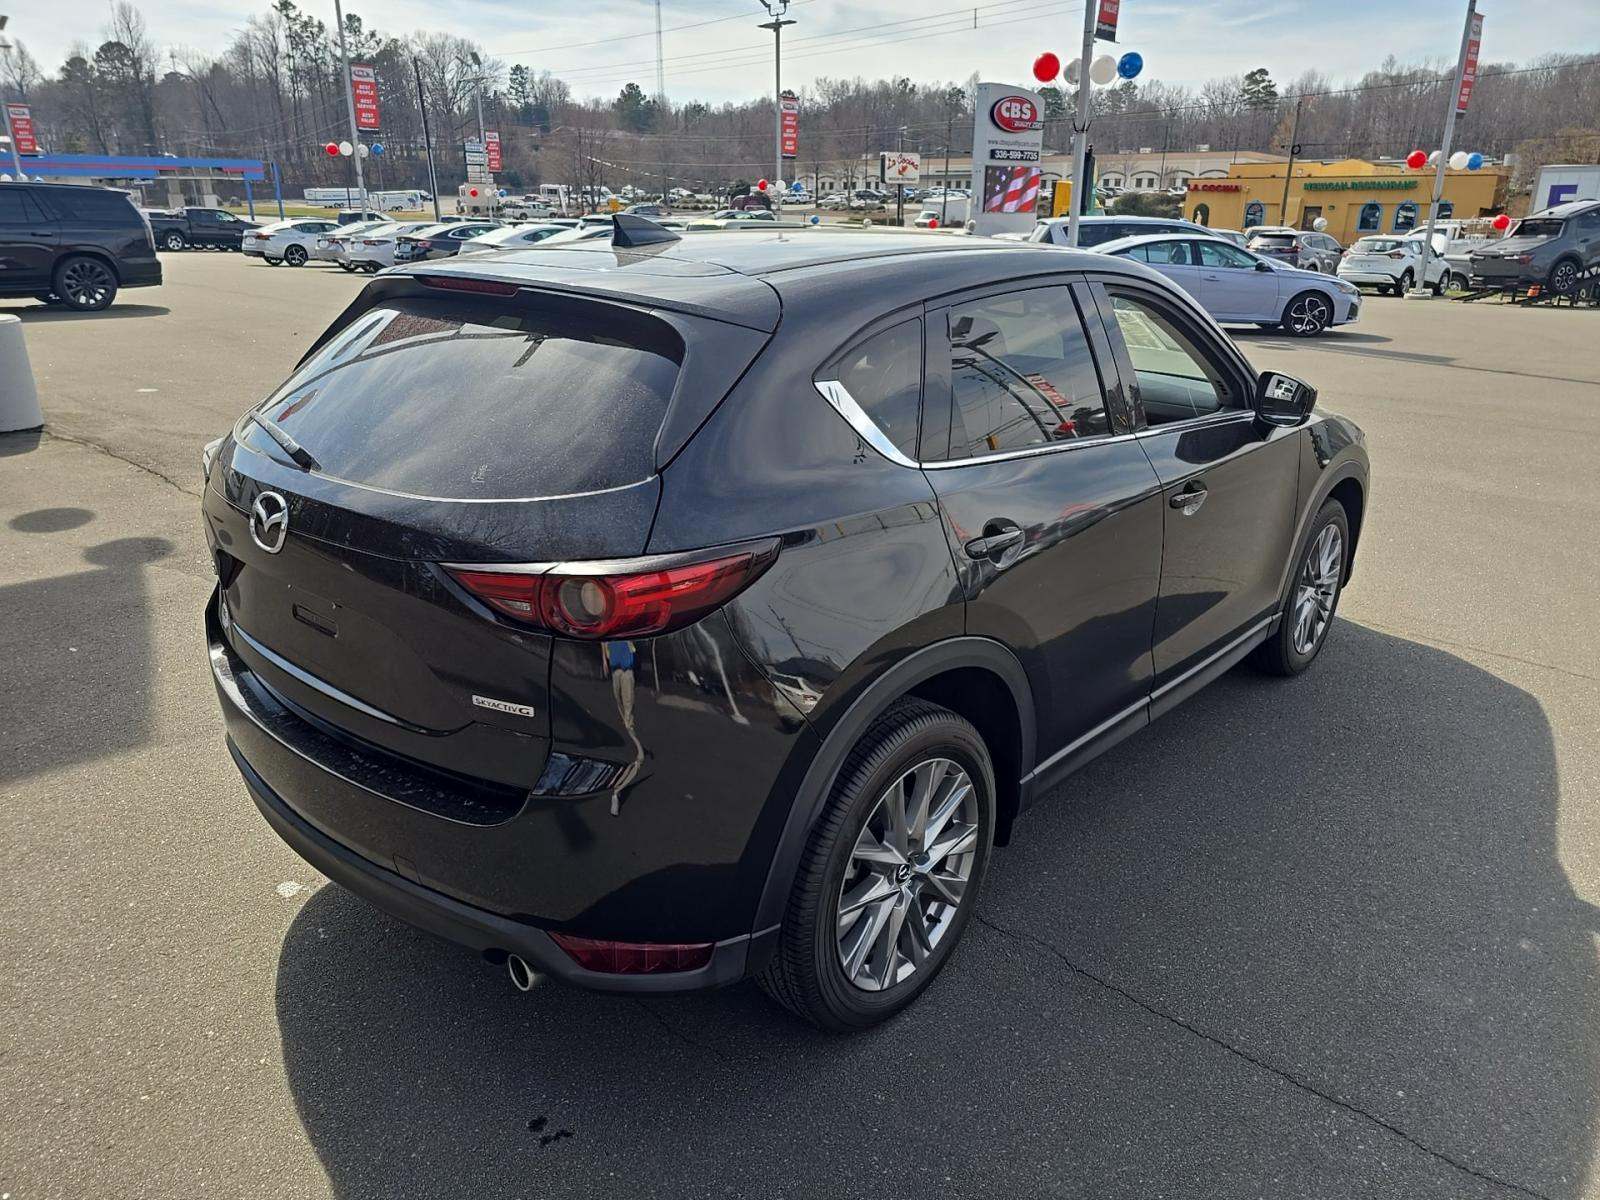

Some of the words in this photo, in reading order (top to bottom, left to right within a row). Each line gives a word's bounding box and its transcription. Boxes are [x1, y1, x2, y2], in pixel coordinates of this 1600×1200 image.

[1001, 101, 1032, 120] CBS
[1187, 183, 1199, 192] LA
[1201, 184, 1240, 193] COCINA
[1303, 181, 1348, 192] MEXICAN
[1350, 180, 1418, 191] RESTAURANT
